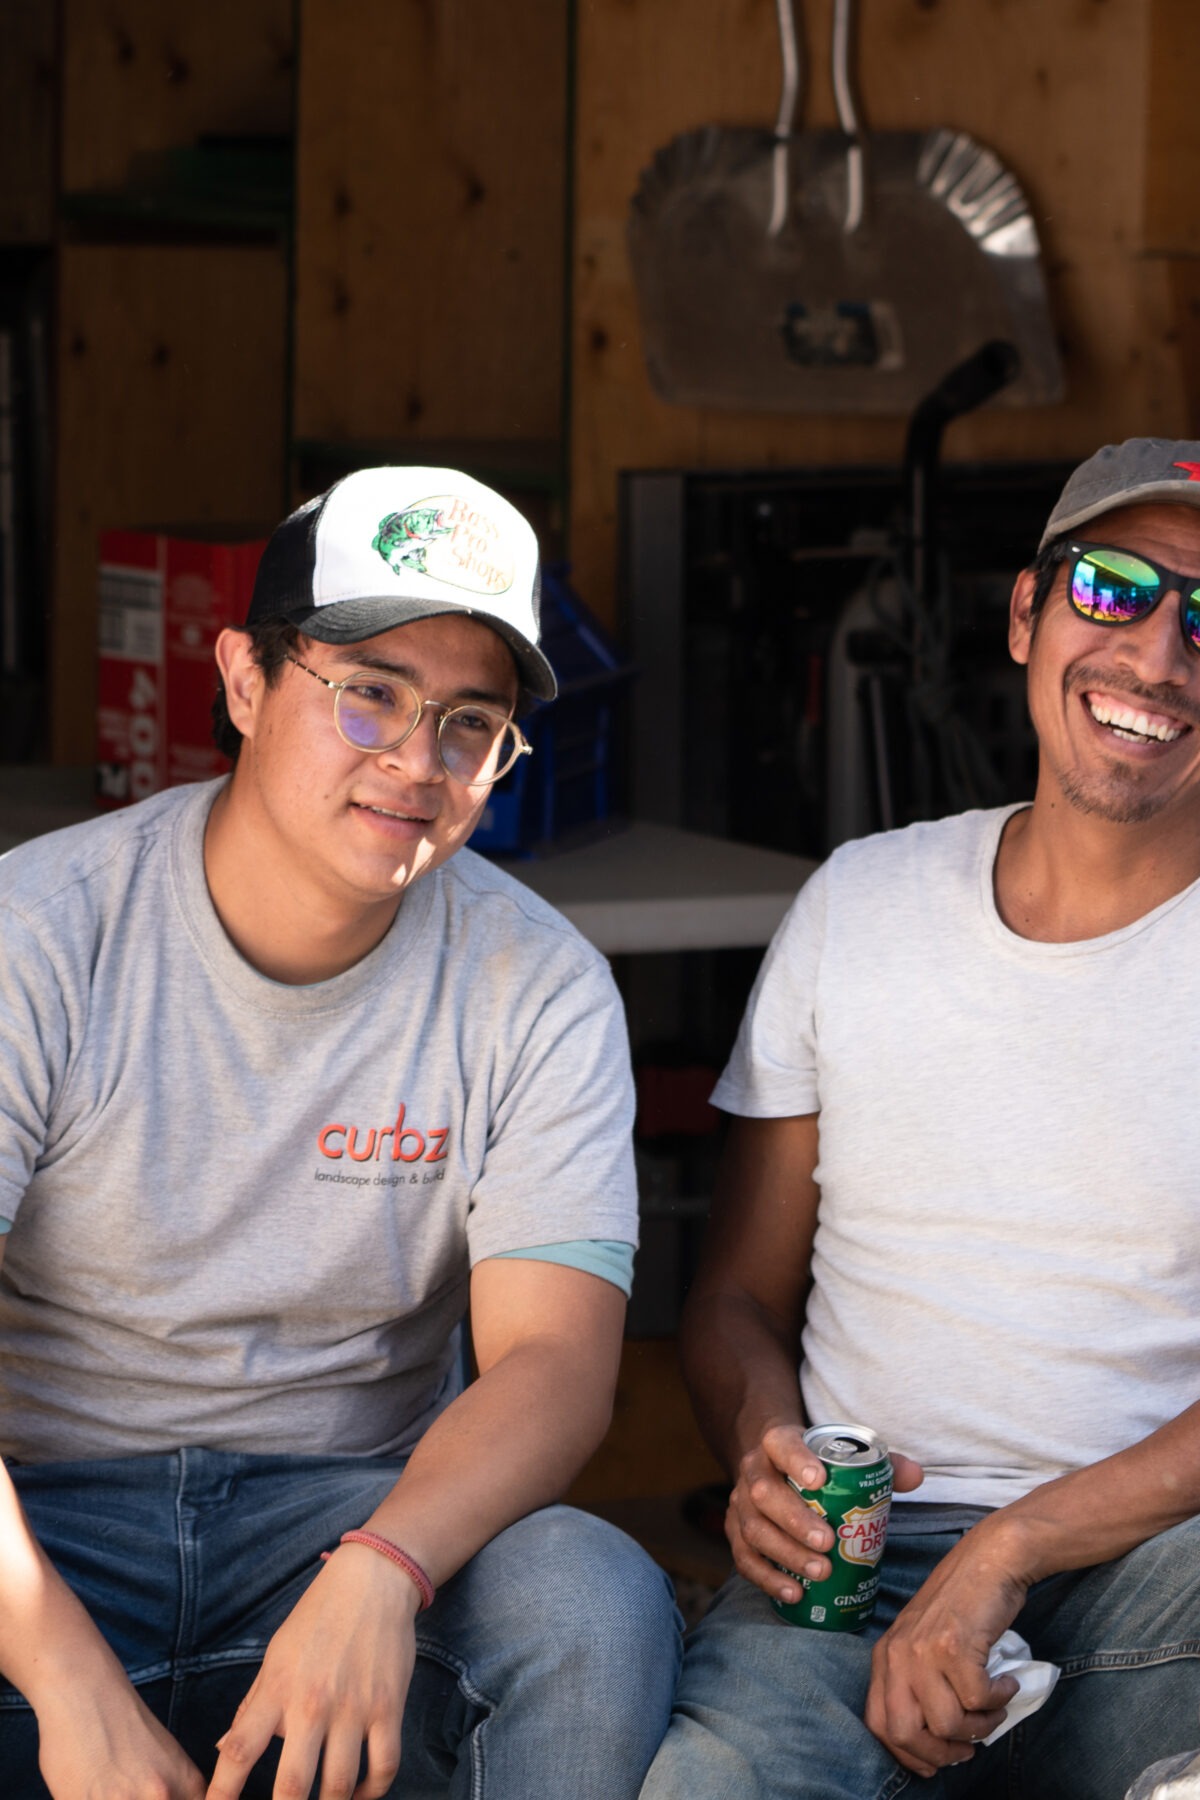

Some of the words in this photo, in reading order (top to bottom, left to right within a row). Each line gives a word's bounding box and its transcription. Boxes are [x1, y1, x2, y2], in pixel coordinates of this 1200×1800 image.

[317, 1101, 450, 1163] curbz
[314, 1168, 371, 1189] landscape
[373, 1172, 406, 1188] degn
[409, 1173, 418, 1184] &
[838, 1515, 887, 1539] CANA
